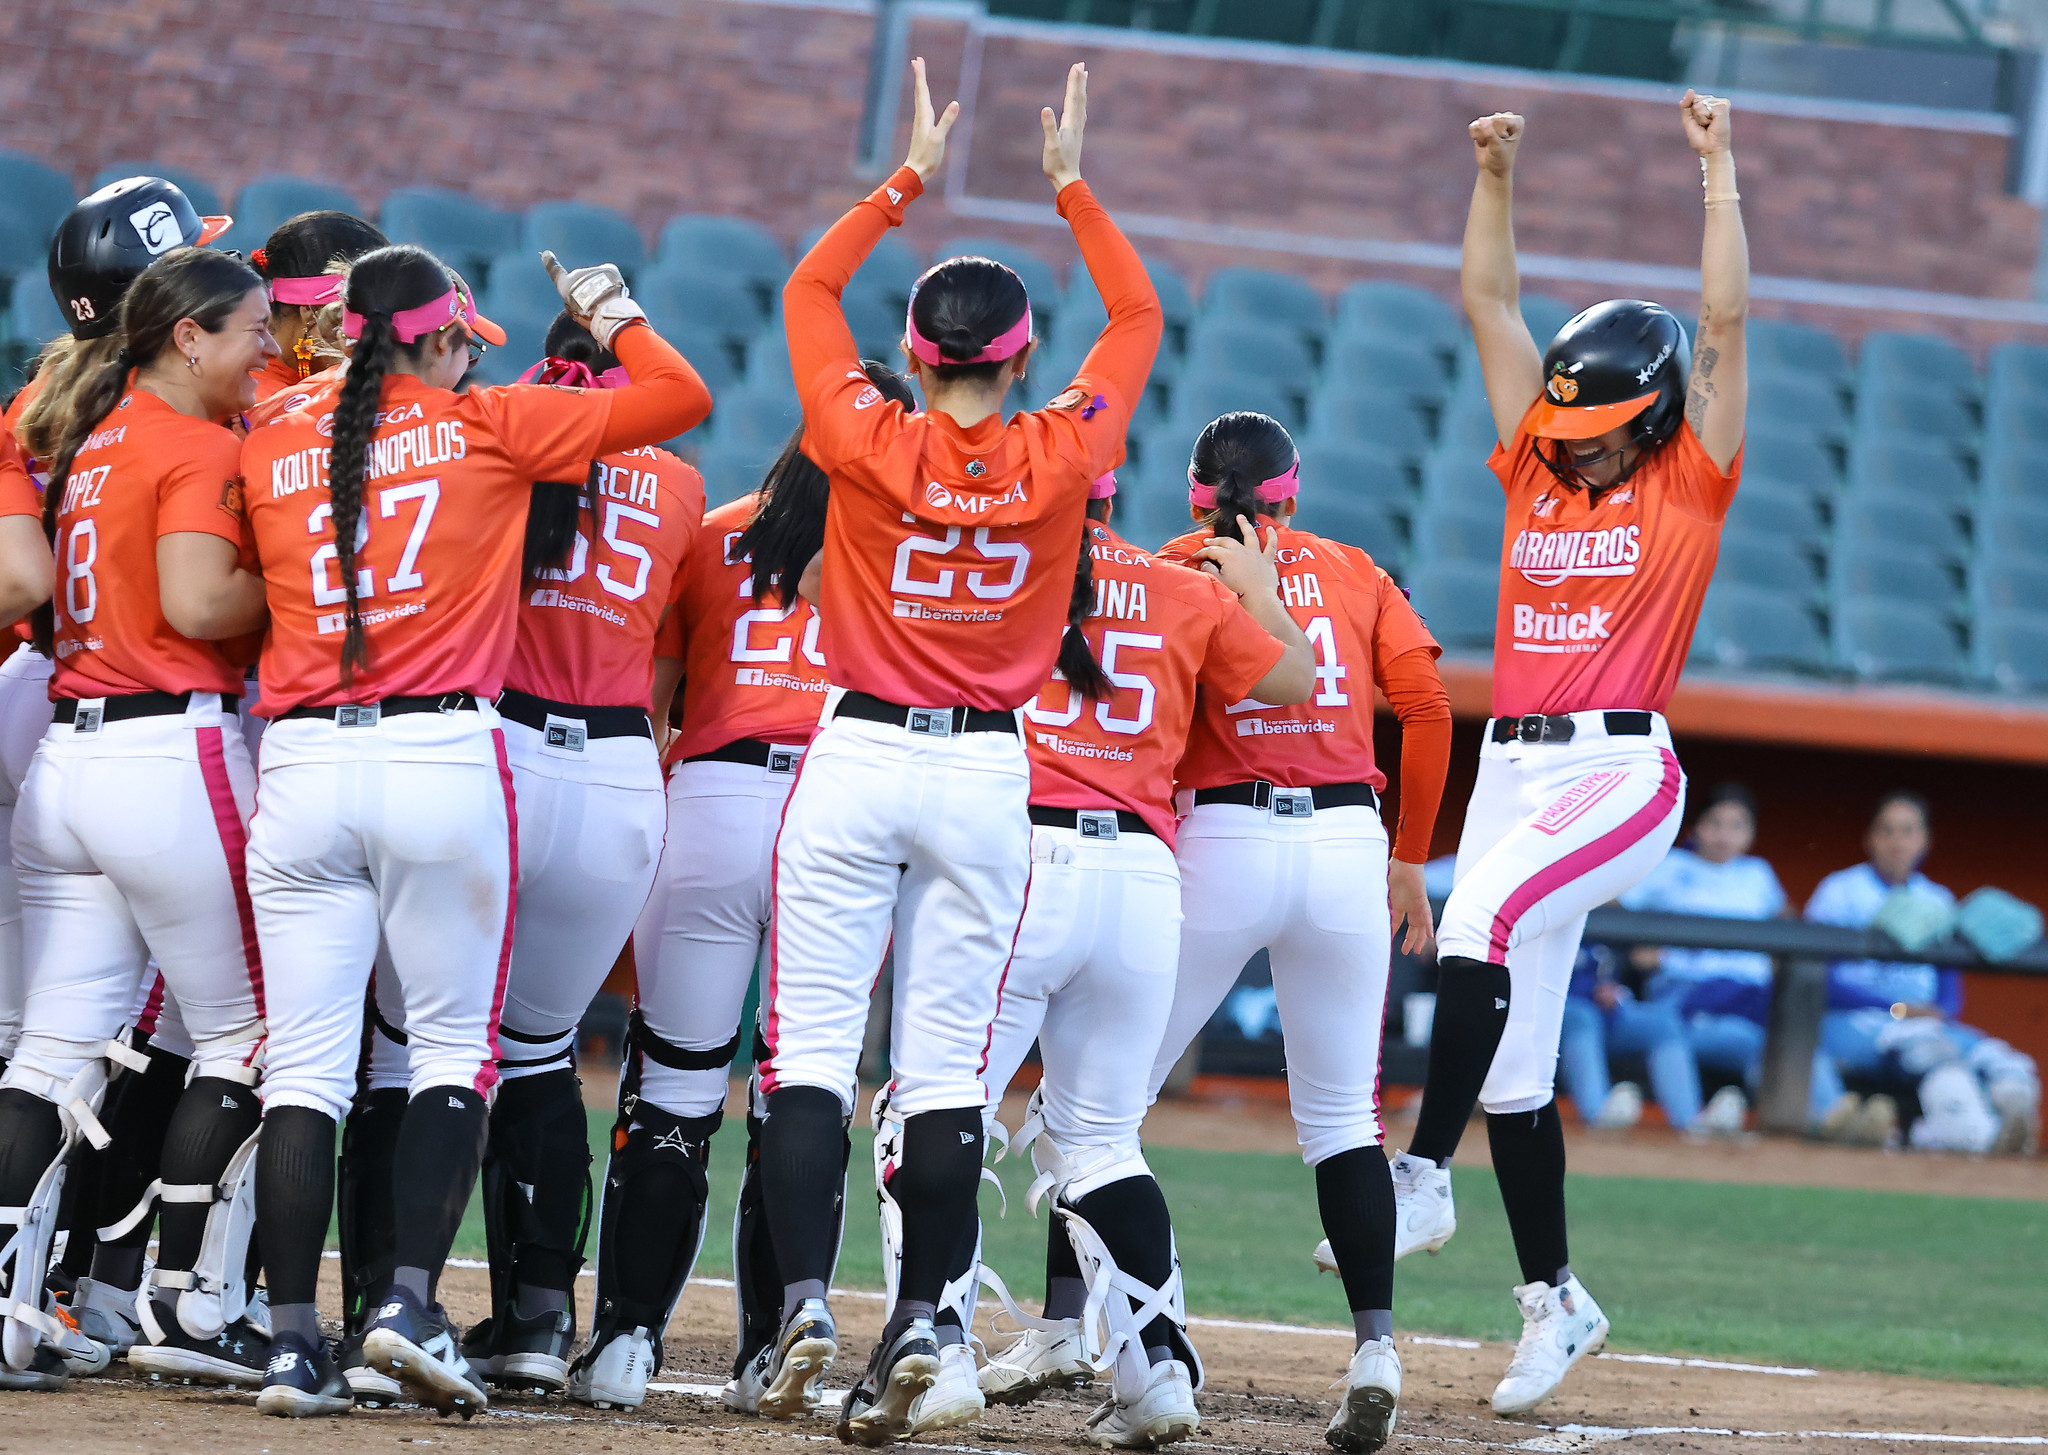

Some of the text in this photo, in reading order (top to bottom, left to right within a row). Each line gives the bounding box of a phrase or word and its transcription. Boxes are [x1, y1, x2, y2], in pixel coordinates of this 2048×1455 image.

[70, 297, 96, 321] 23
[373, 402, 424, 427] EGA
[272, 421, 467, 499] KOUTSANOPULOS
[57, 465, 112, 518] OPEZ
[583, 461, 658, 510] RCIA
[307, 477, 442, 607] 27
[1509, 524, 1641, 578] ARANJEROS
[890, 525, 1031, 600] 25
[359, 603, 427, 626] enavides
[558, 594, 626, 626] benavides
[921, 607, 1003, 622] benavides
[1088, 579, 1147, 622] UNA
[1513, 601, 1614, 642] Brück
[763, 673, 832, 693] benavide
[1263, 719, 1336, 734] benavides
[1057, 739, 1134, 762] benavides
